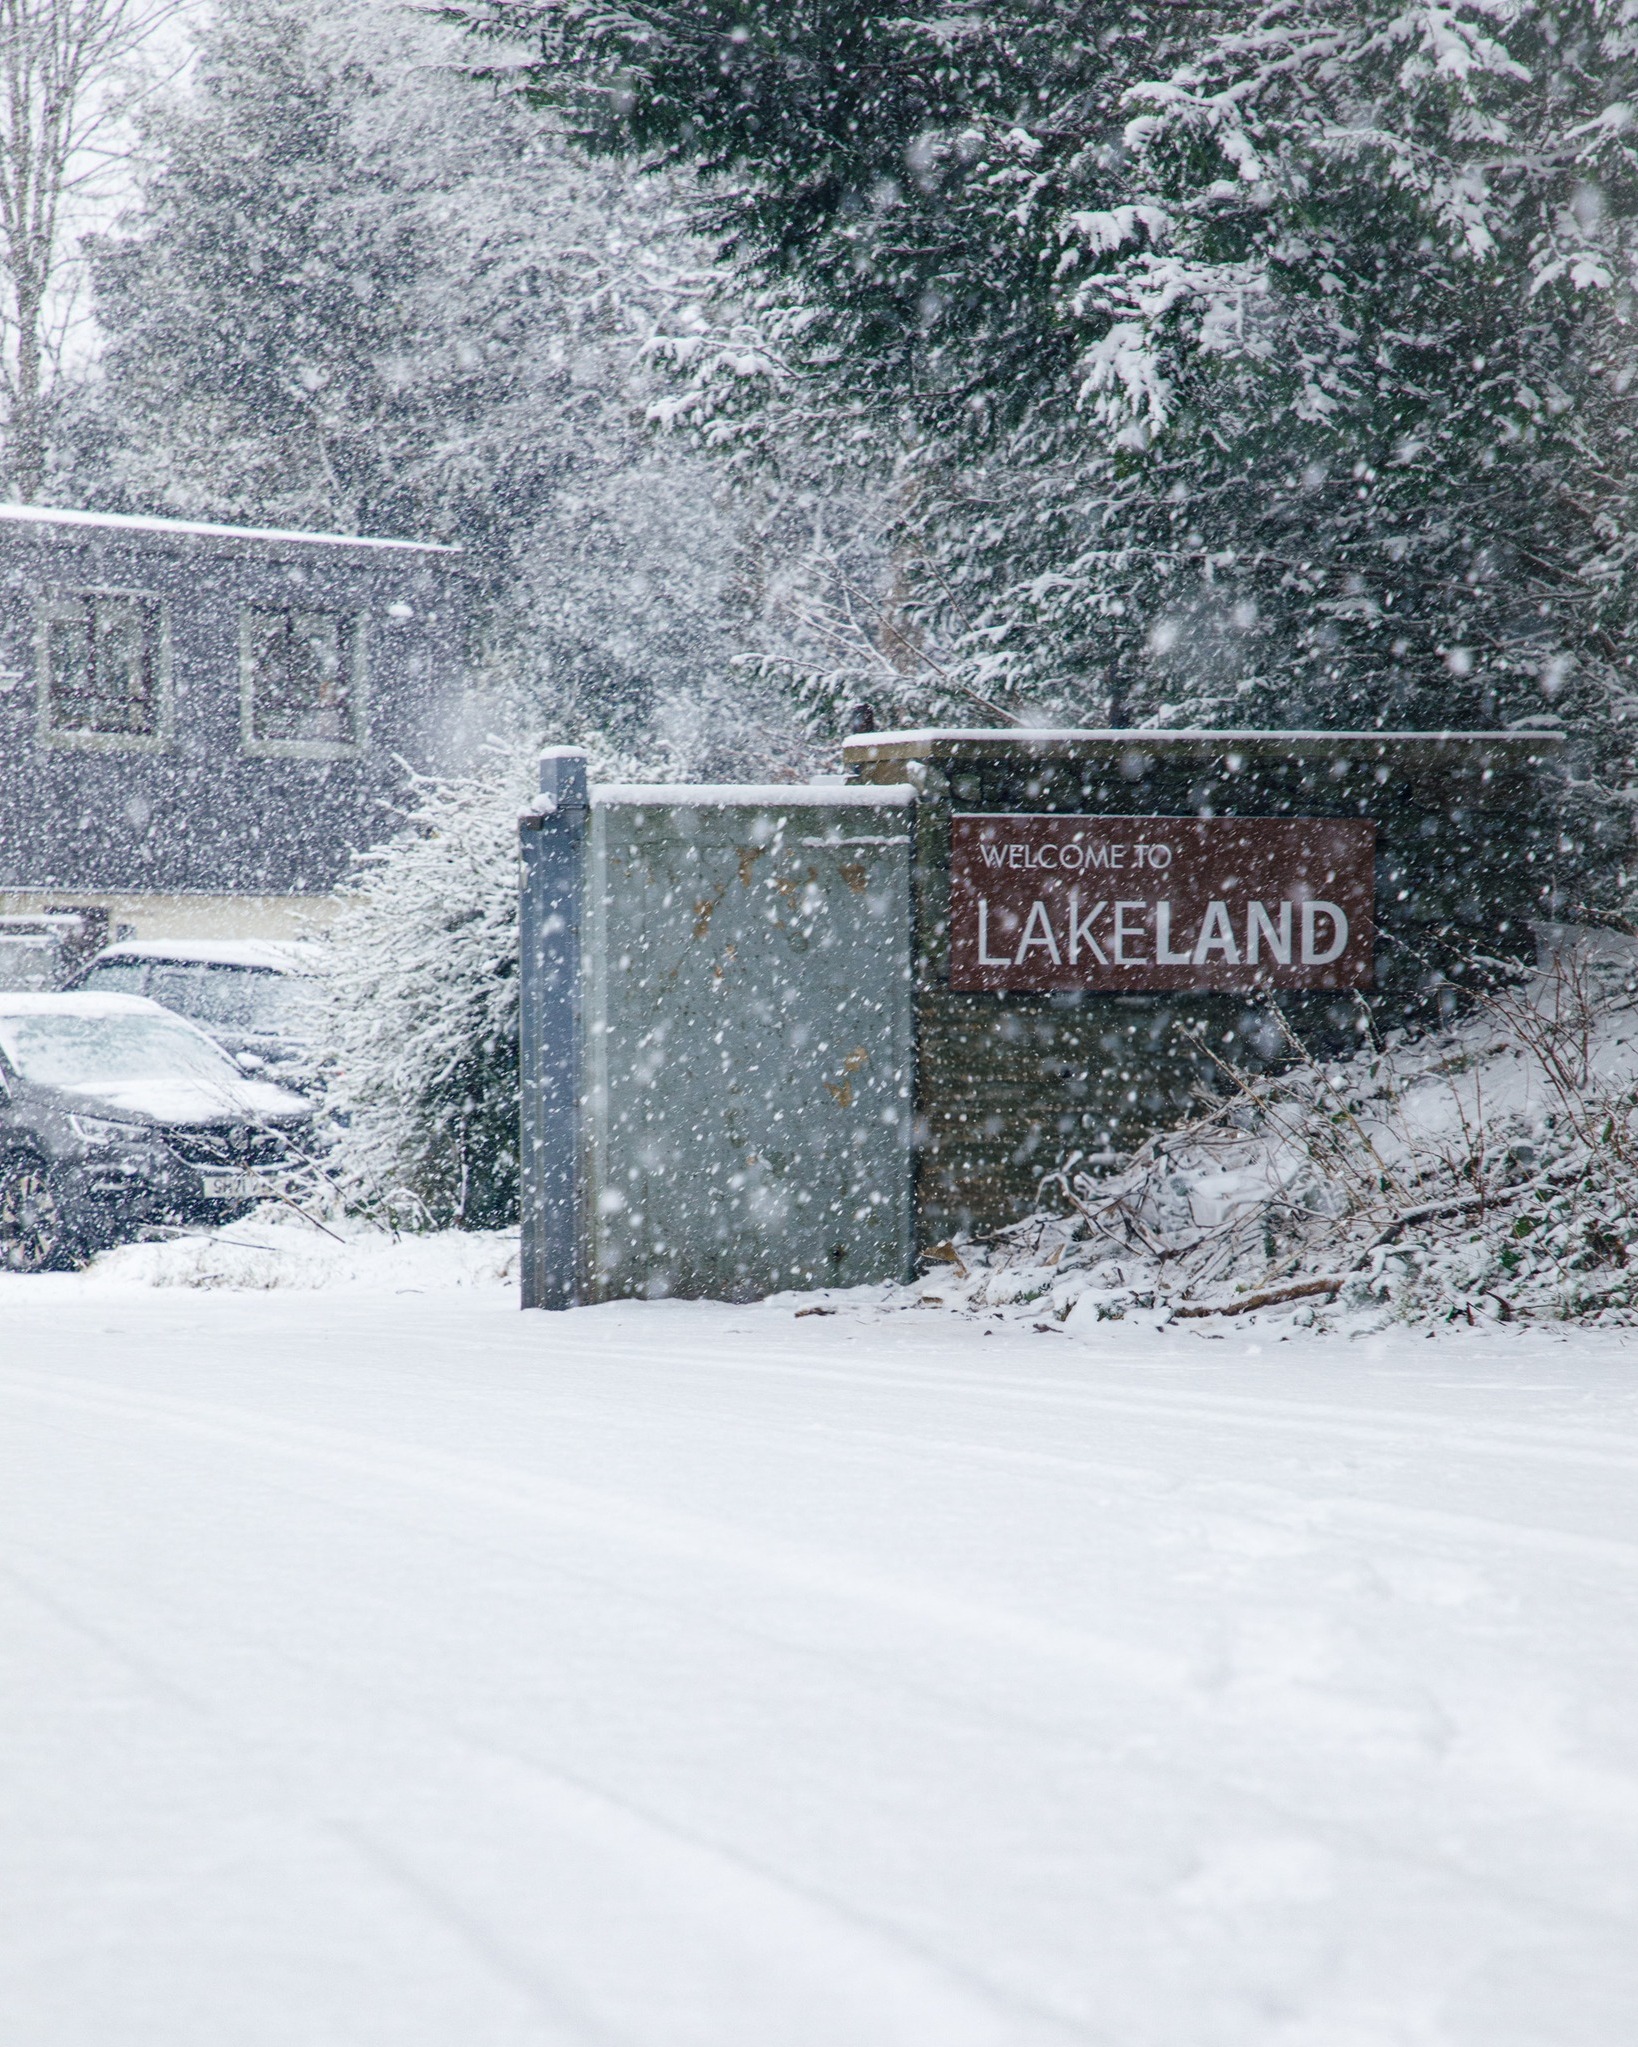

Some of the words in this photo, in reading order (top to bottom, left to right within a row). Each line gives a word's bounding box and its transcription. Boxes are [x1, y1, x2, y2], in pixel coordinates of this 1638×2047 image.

[980, 845, 1124, 869] WELCOME
[1133, 845, 1171, 869] TO
[978, 900, 1349, 965] LAKELAND
